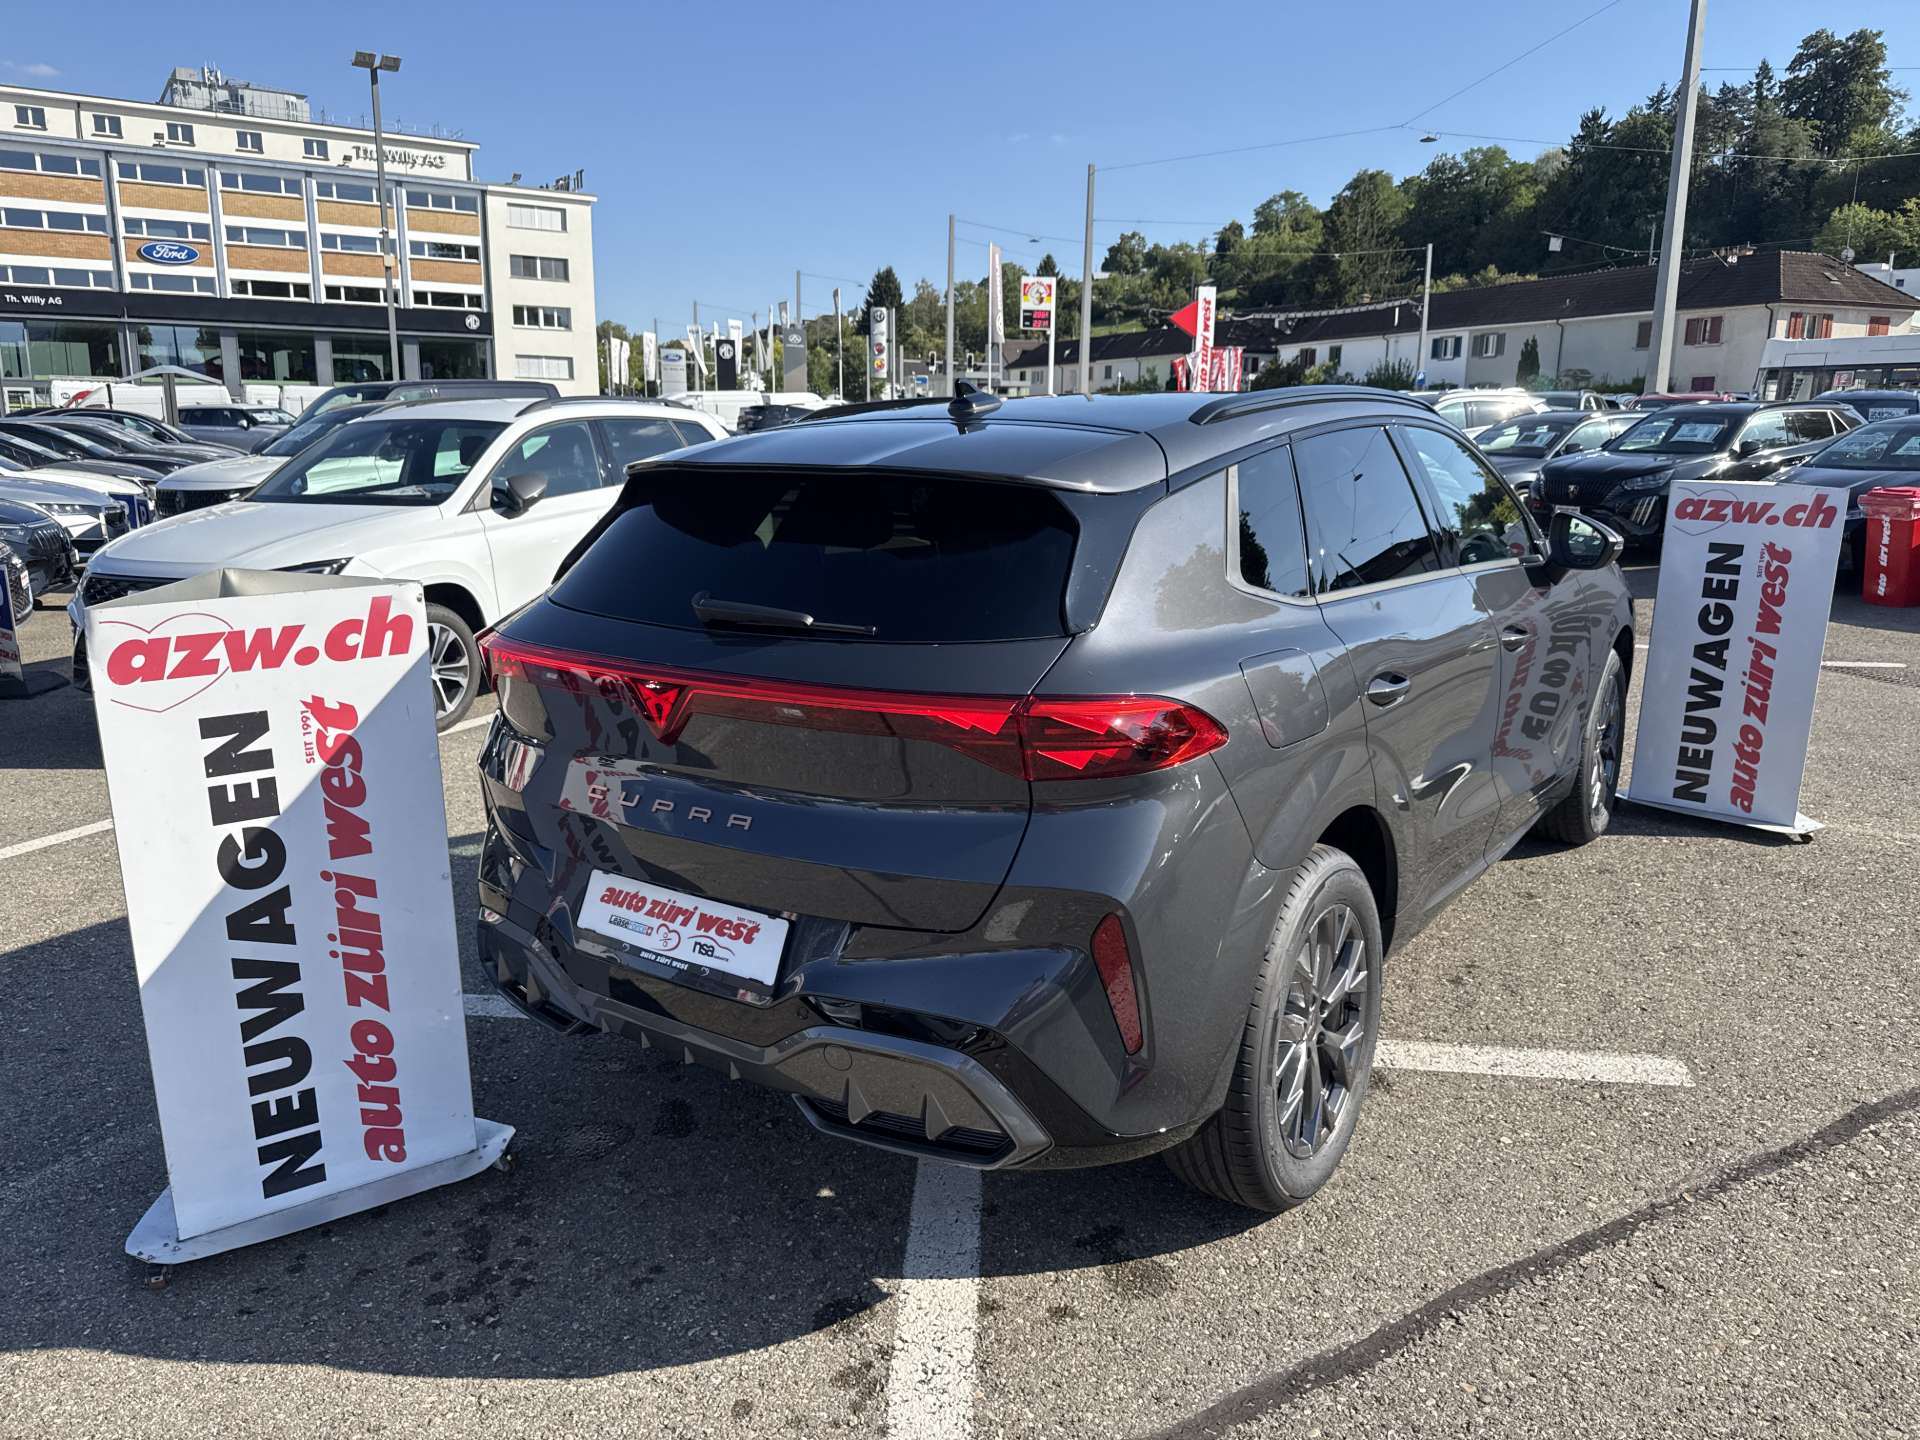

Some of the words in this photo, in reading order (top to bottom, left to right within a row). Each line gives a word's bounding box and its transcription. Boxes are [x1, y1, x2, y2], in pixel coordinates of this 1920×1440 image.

[152, 244, 188, 260] Ford
[4, 294, 20, 303] Th.
[21, 295, 46, 306] Willy
[47, 296, 63, 305] AG
[1675, 494, 1838, 529] azw.ch
[1755, 541, 1792, 635] west
[106, 597, 414, 686] azw.ch
[1673, 542, 1745, 804] NEUWAGEN
[1740, 636, 1777, 726] züri
[300, 710, 312, 736] 1991
[304, 741, 316, 764] SEIT
[299, 695, 373, 861] west
[1730, 724, 1764, 814] auto
[587, 784, 753, 831] CUPRA
[320, 870, 391, 1013] züri
[600, 886, 648, 913] auto
[644, 898, 699, 927] züri
[696, 911, 761, 945] west
[692, 941, 715, 957] nsa
[198, 711, 327, 1199] NEUWAGEN
[640, 950, 656, 961] auto
[671, 960, 689, 971] west
[343, 1019, 408, 1163] auto
